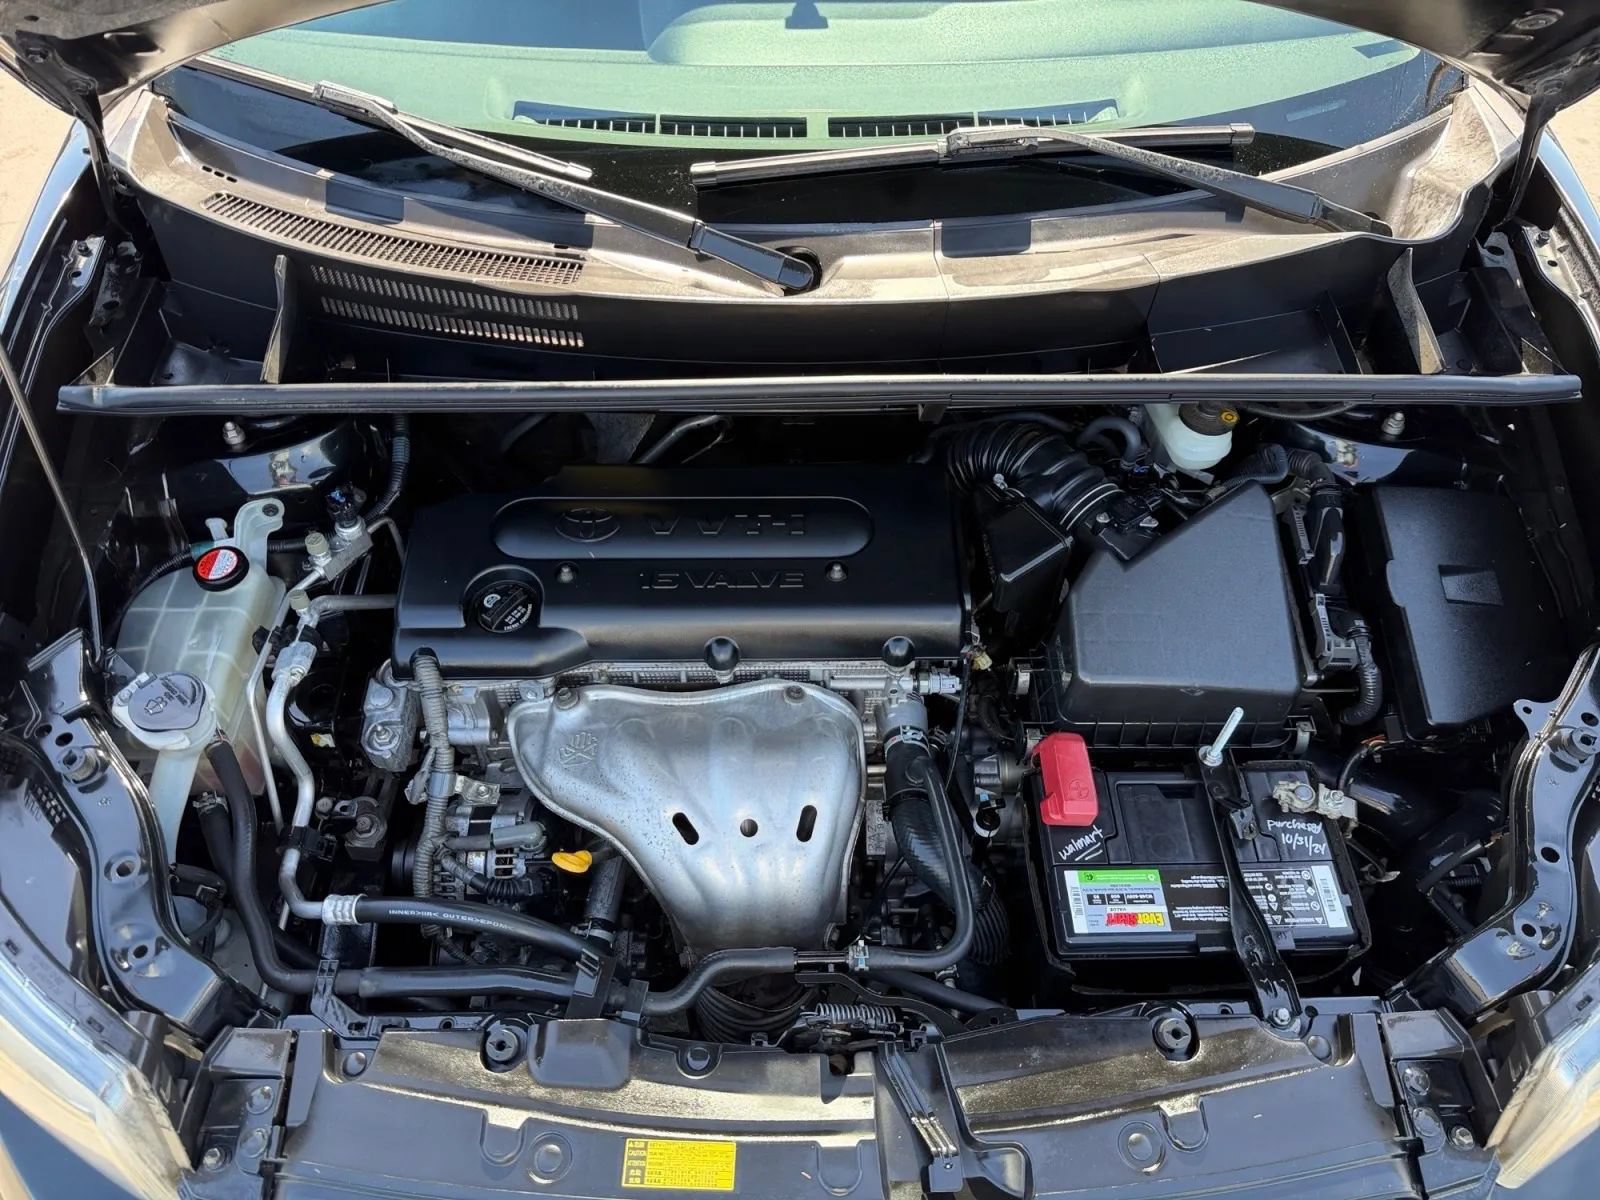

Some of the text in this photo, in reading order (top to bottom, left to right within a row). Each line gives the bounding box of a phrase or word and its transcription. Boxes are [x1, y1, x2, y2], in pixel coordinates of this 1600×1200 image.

[684, 571, 805, 589] VALVE
[1281, 831, 1326, 857] 10/31/24
[1105, 911, 1165, 928] EverStart
